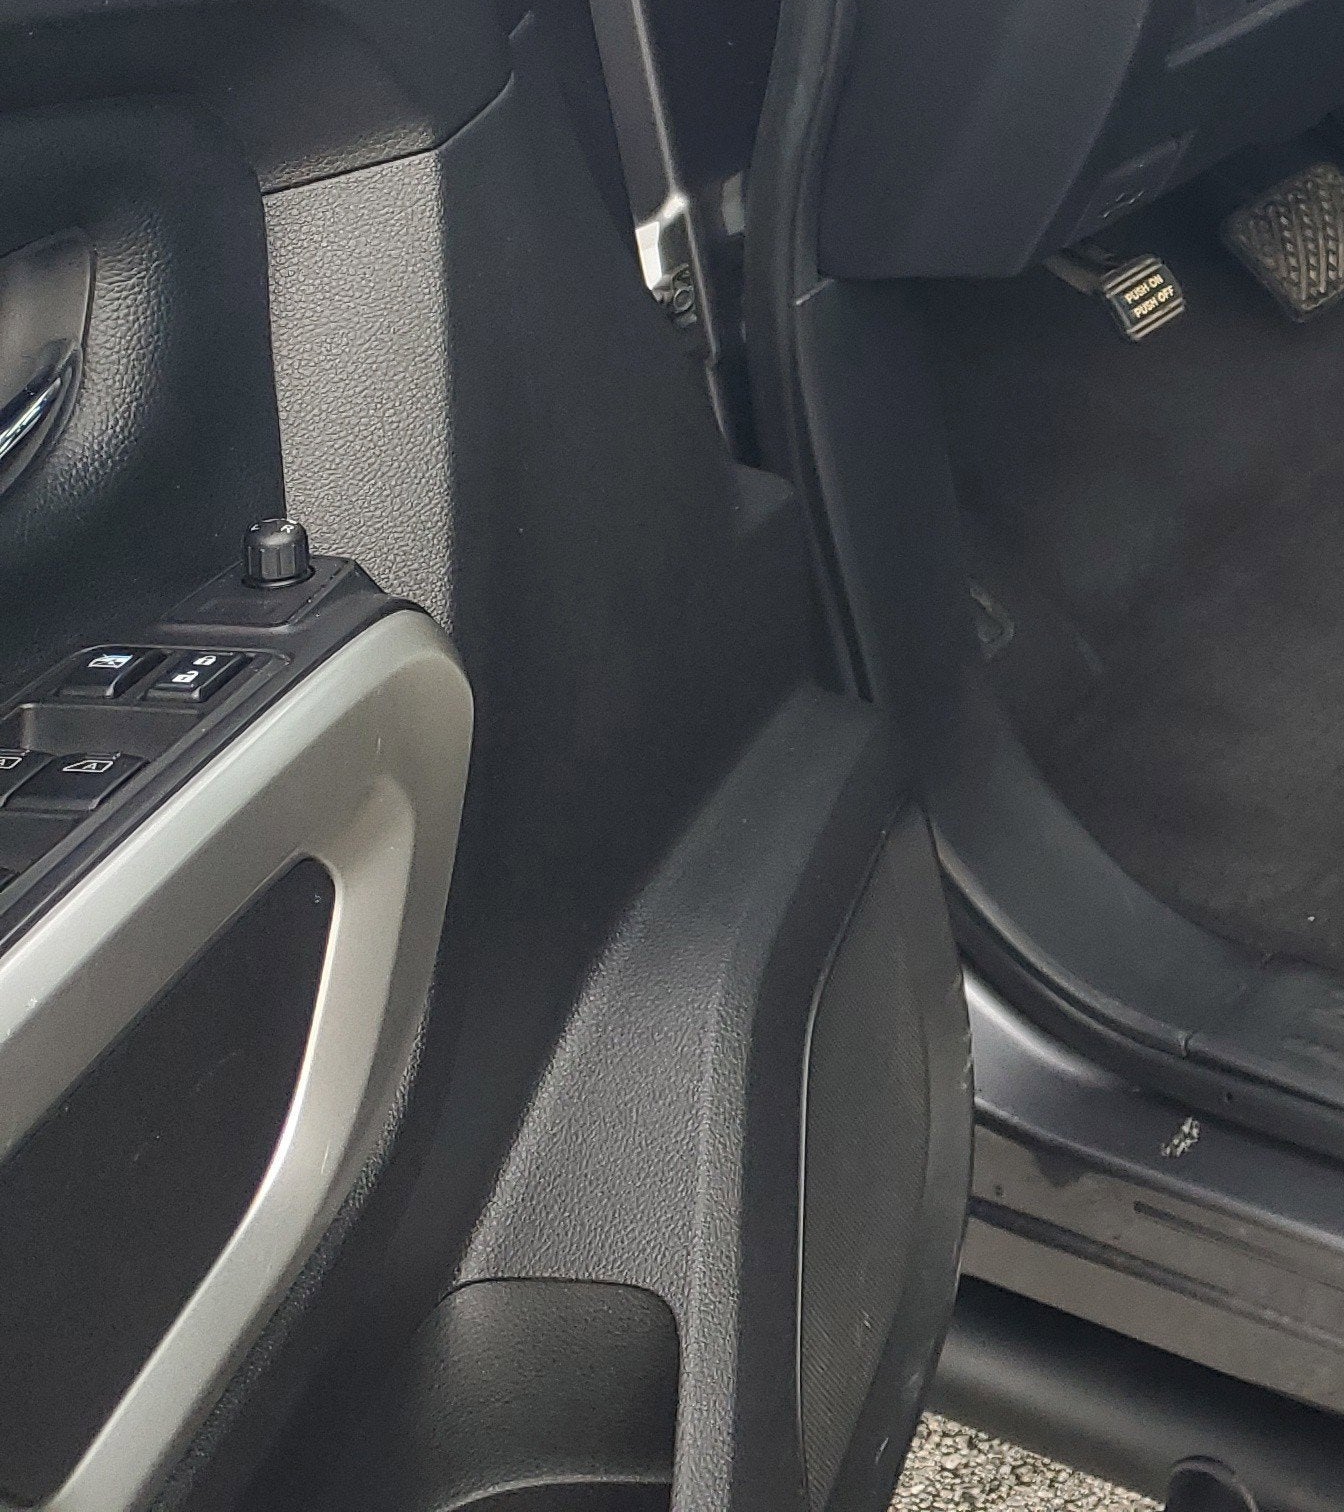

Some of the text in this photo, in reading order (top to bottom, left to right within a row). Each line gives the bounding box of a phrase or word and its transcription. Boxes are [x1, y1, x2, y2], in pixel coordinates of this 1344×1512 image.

[1124, 274, 1164, 304] PUSH ON
[1134, 285, 1174, 318] PUSH OFF
